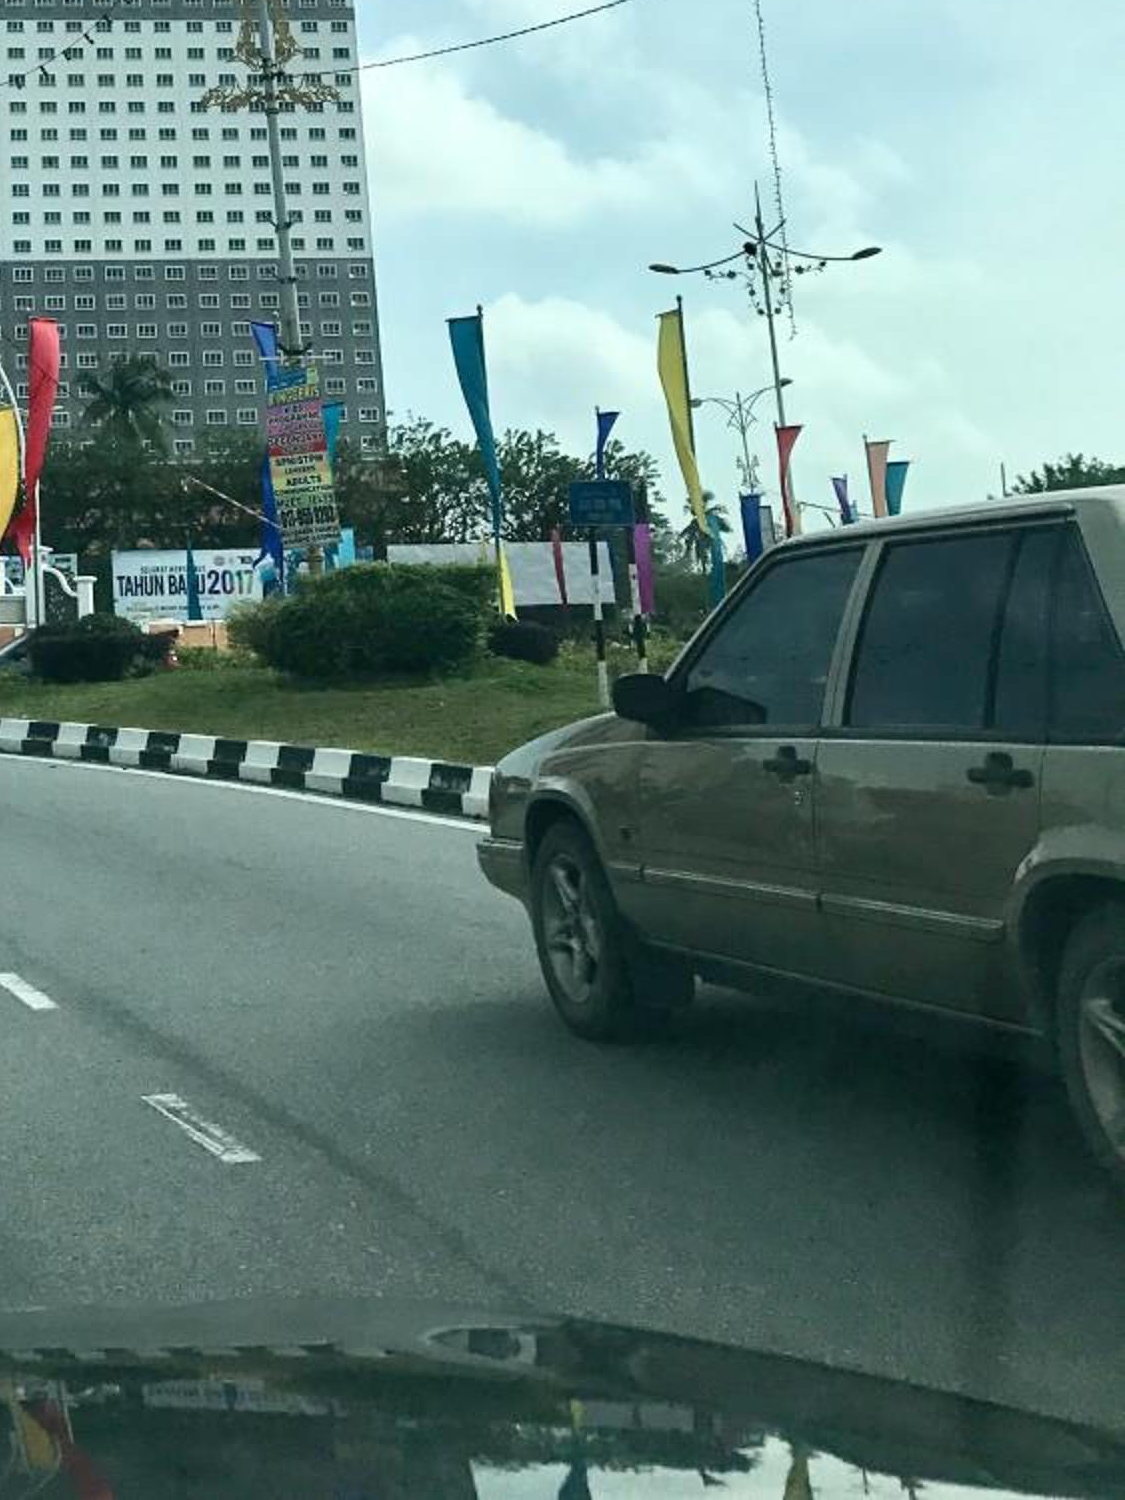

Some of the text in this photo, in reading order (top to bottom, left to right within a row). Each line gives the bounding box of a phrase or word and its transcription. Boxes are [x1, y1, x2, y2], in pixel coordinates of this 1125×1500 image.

[116, 569, 253, 597] TAHUN BAU 2017
